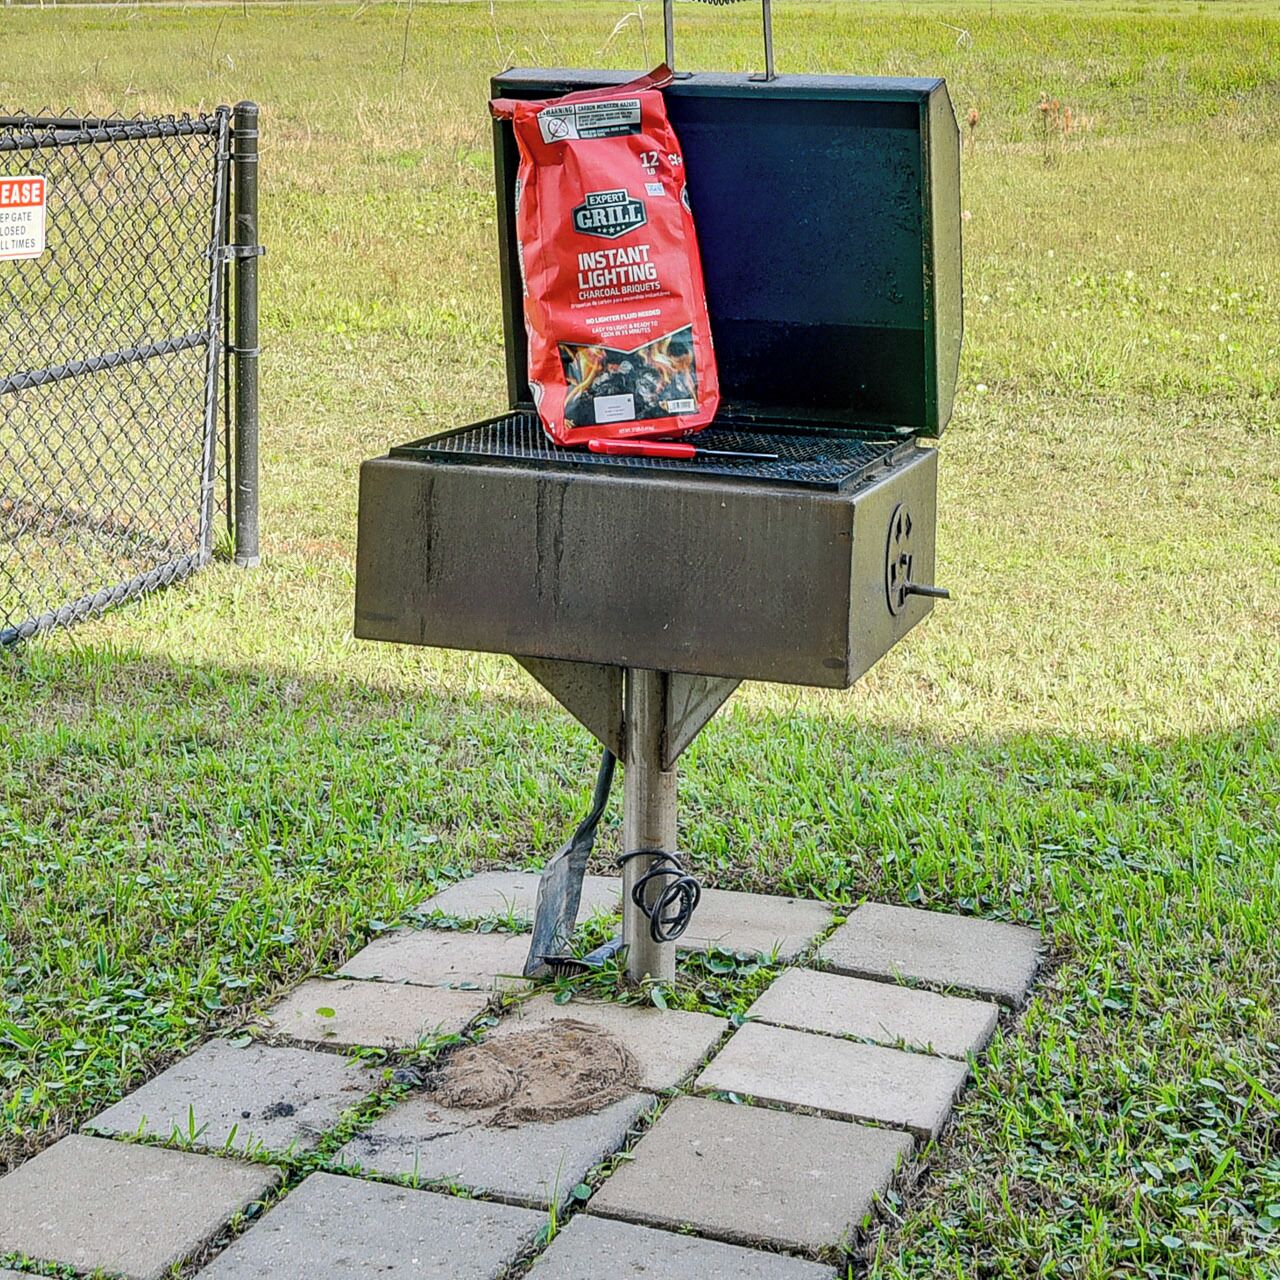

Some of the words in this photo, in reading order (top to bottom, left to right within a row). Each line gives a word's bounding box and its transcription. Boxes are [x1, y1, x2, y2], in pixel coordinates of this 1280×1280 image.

[640, 151, 659, 168] 12
[589, 192, 624, 205] EXPERT
[11, 212, 32, 222] GATE
[576, 204, 642, 229] GRILL
[12, 238, 36, 249] TIMES
[578, 244, 650, 270] INSTANT
[578, 262, 657, 289] LIGHTING
[578, 288, 620, 300] CHARCOAL
[621, 281, 660, 294] BRIQUETS
[595, 314, 620, 324] LIGHTER
[620, 312, 638, 320] FLUID
[638, 309, 661, 318] NEEDED
[592, 326, 606, 334] EASY
[633, 321, 650, 329] READY
[628, 327, 651, 335] MINUTES
